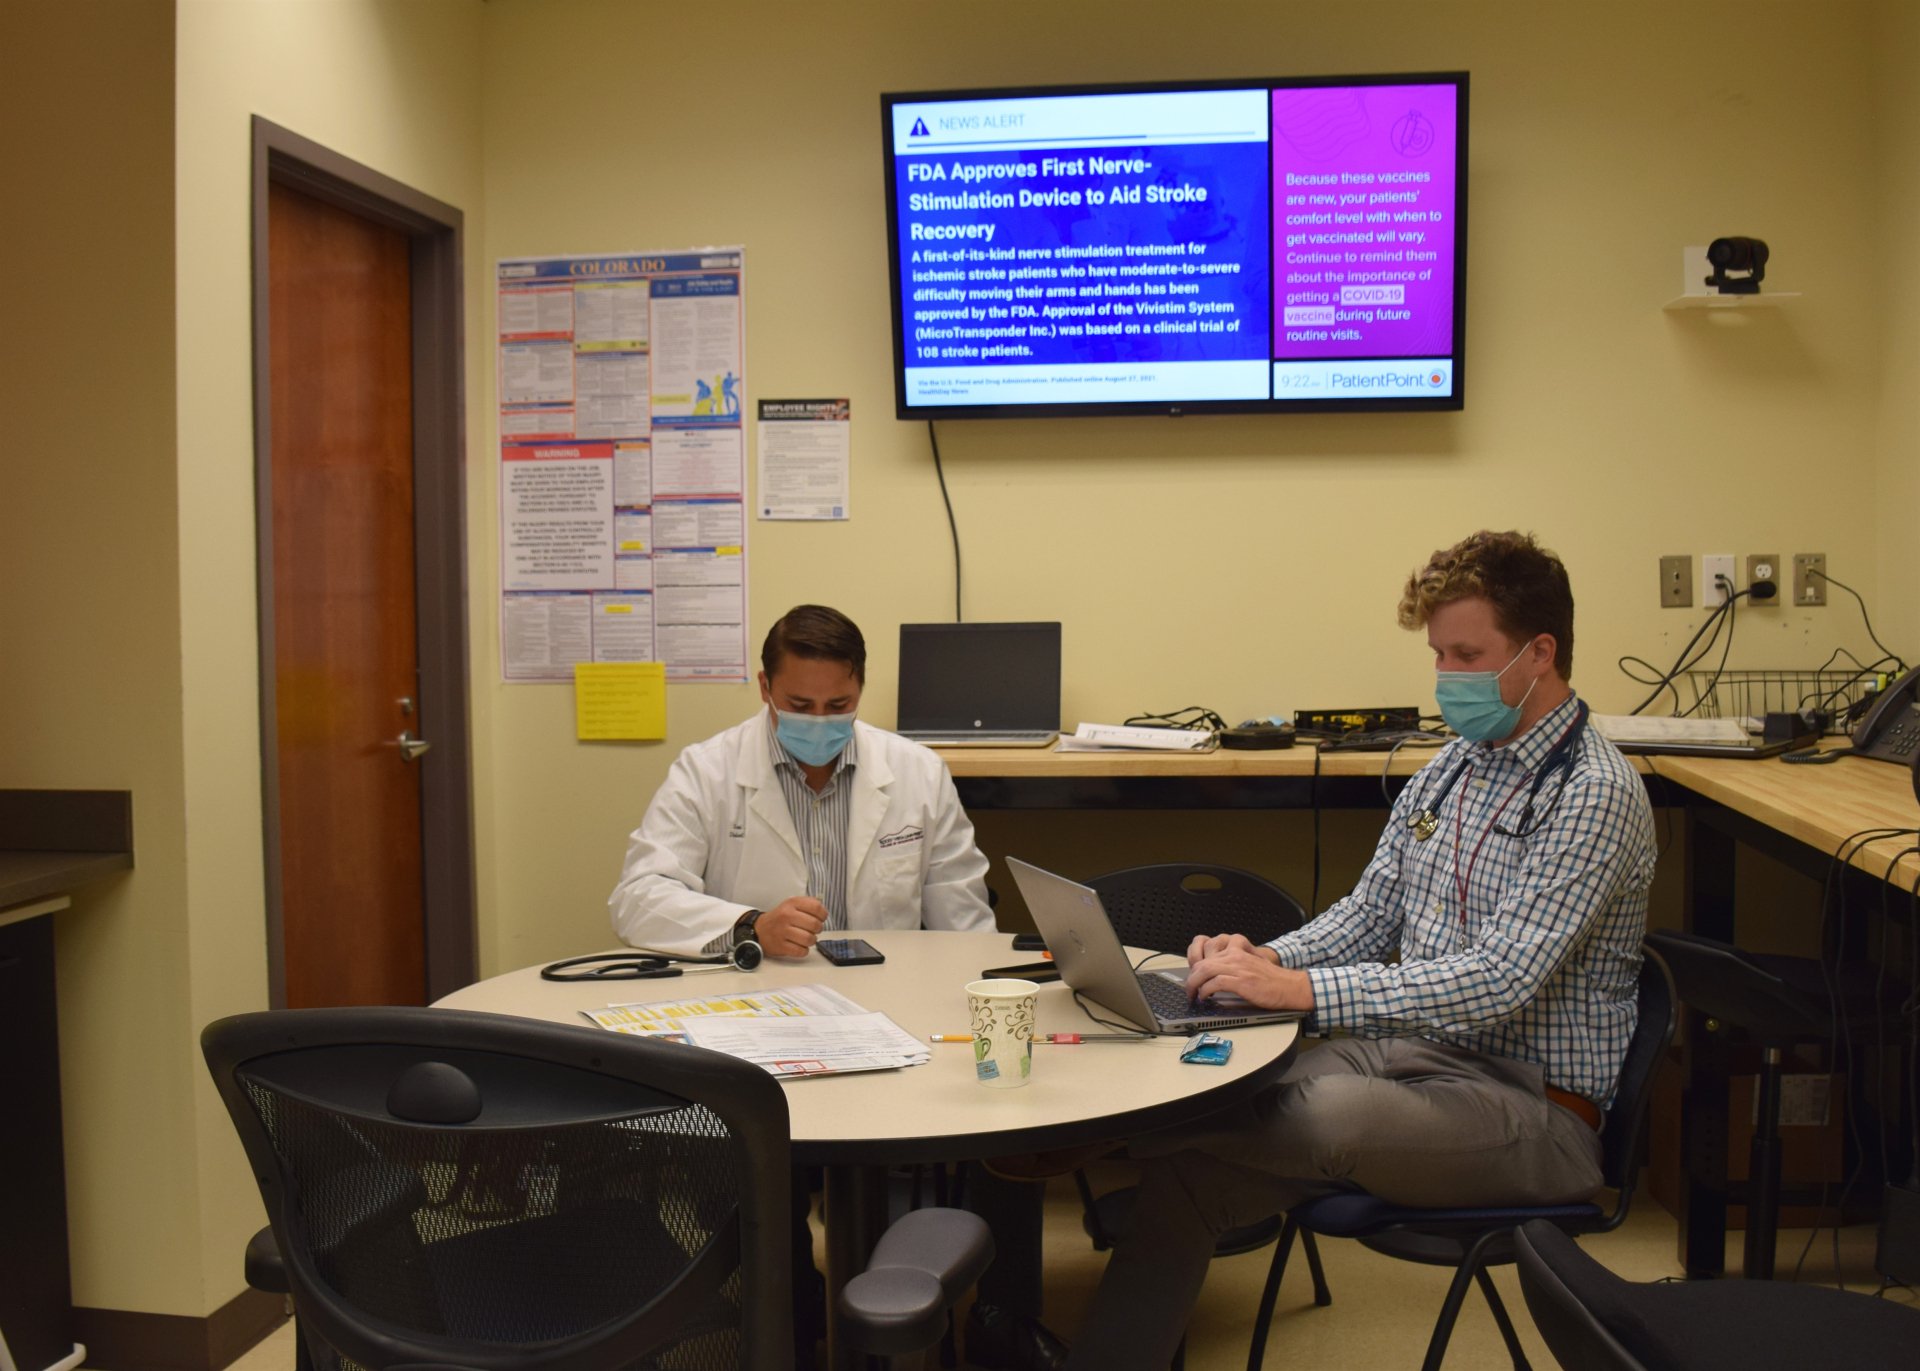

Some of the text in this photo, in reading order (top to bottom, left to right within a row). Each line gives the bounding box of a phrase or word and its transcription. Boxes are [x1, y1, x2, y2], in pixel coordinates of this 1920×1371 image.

[938, 112, 1024, 130] NEWS ALERT
[907, 156, 1152, 184] FDA Approves First Nerve-
[1285, 171, 1430, 186] Because these vaccines
[909, 182, 1208, 211] Stimulation Device to Aid Stroke
[1286, 189, 1420, 206] are new, your patients'
[1285, 210, 1442, 225] comfort level with when to
[910, 222, 996, 242] Recovery
[1286, 229, 1426, 247] get vaccinated will vary.
[911, 241, 1206, 263] A first-of-its-kind nerve stimulation treatment for
[1286, 249, 1437, 264] Continue to remind them
[569, 257, 666, 275] COLORADO
[912, 262, 1240, 282] ischemic stroke patients who have moderate-to-severe
[1286, 268, 1432, 284] about the importance of
[913, 281, 1199, 302] difficulty moving their arms and hands has been
[1286, 290, 1402, 305] getting a COVID-19
[914, 301, 1234, 322] approved by the FDA. Approval of the Vivistim System
[1286, 307, 1411, 323] vaccine during future
[915, 319, 1240, 341] (MicroTransponder Inc.) was based on a clinical trial of
[1286, 328, 1362, 341] routine visits.
[916, 343, 1033, 359] 108 stroke patients.
[985, 378, 1000, 386] Drug
[1105, 376, 1127, 384] August
[1332, 373, 1424, 388] PatientPoint
[534, 449, 581, 458] WARNING
